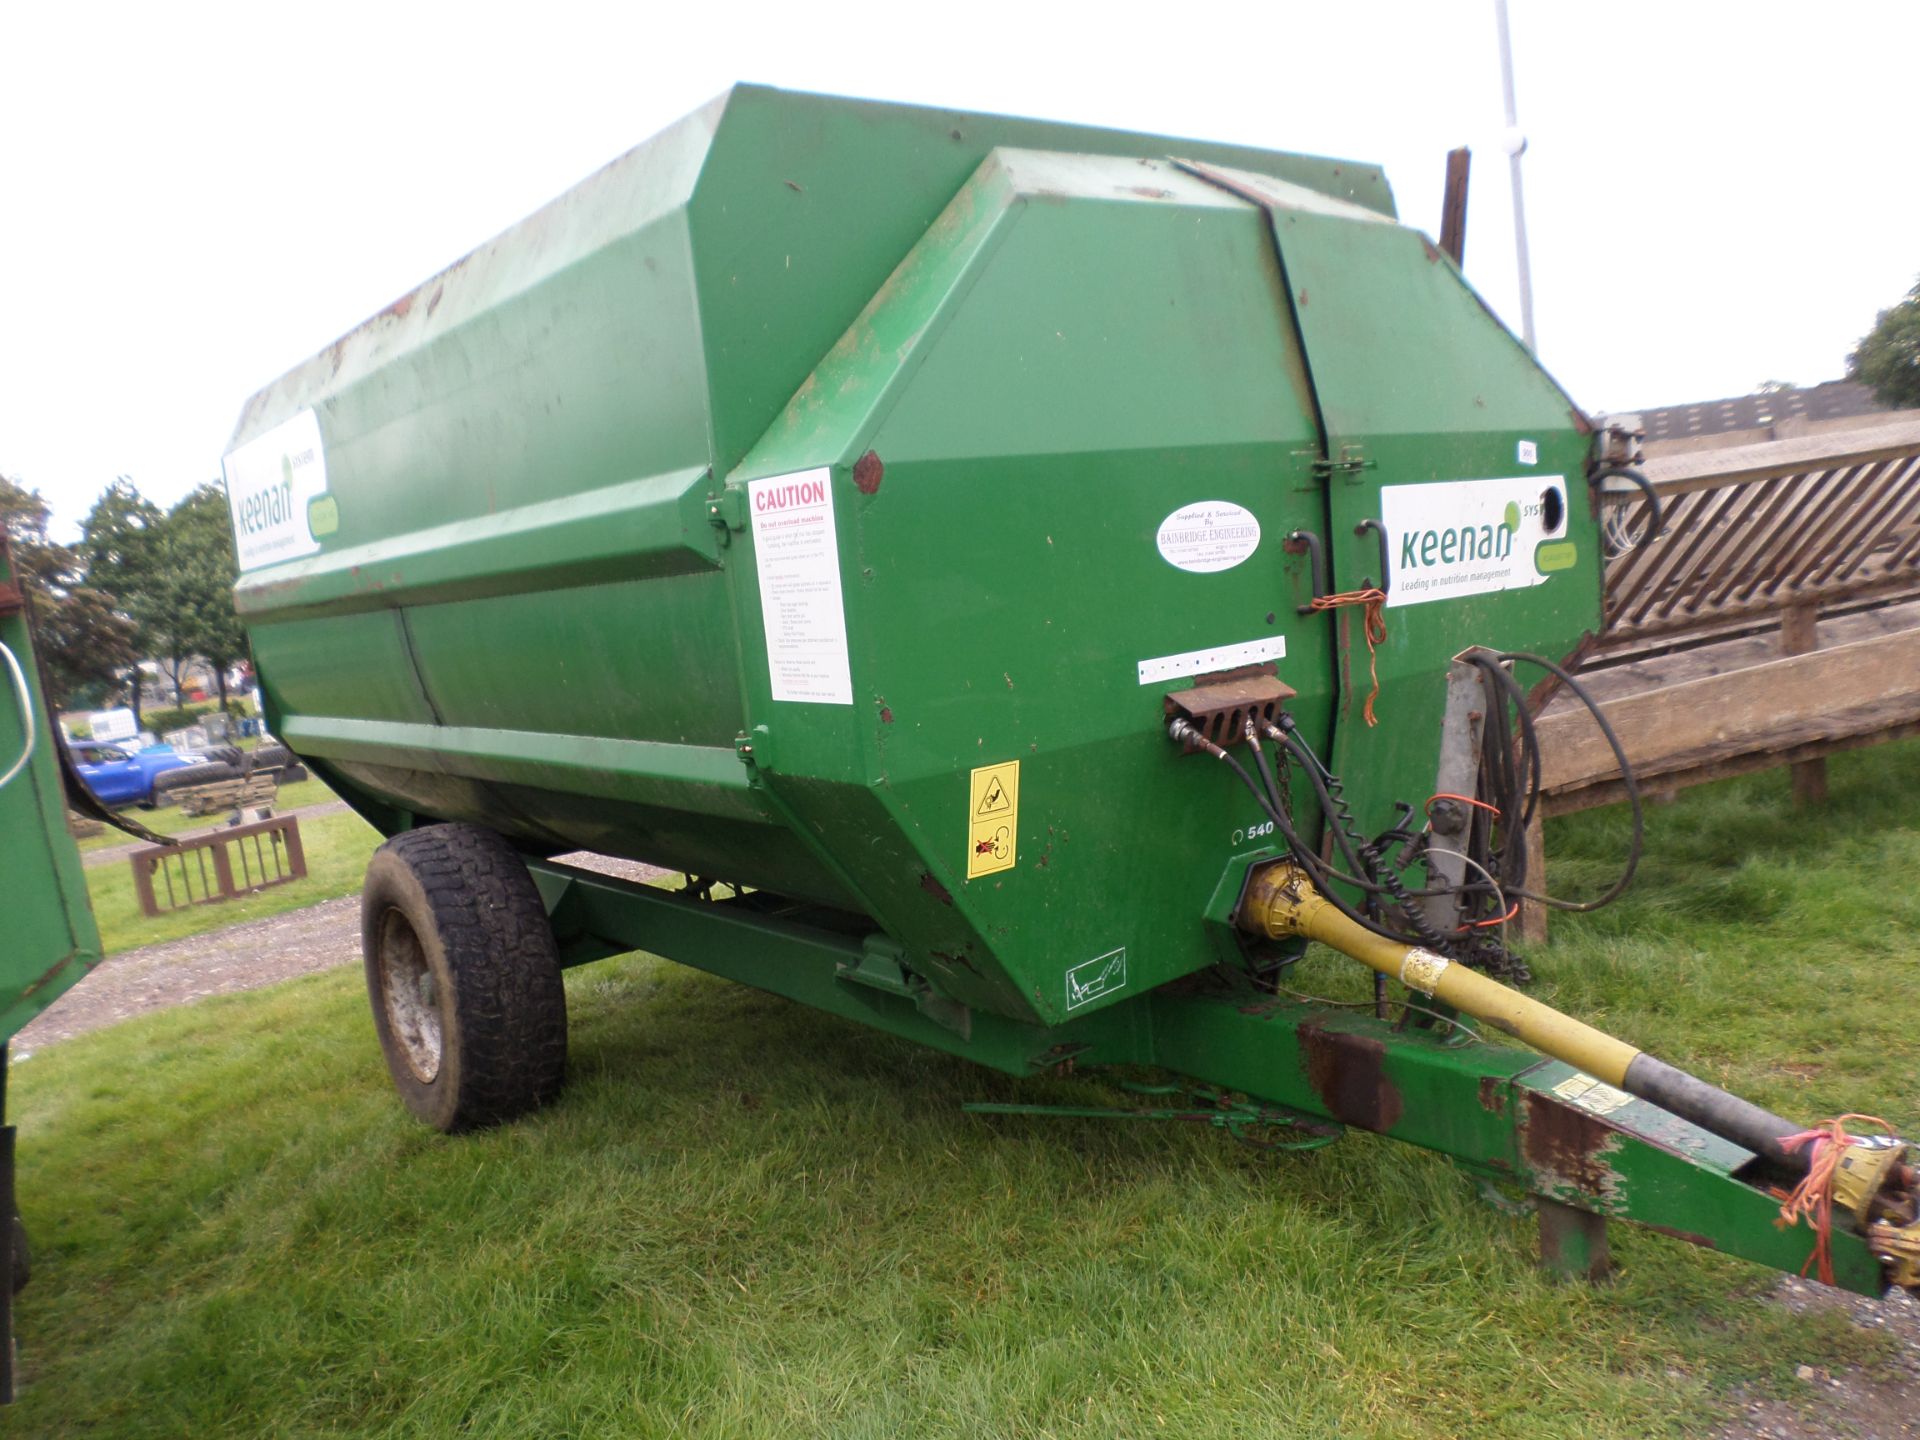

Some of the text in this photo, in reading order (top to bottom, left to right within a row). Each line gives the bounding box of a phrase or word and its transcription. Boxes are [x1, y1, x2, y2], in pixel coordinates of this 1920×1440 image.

[756, 480, 824, 512] CAUTION
[1176, 511, 1205, 521] Supplied
[1204, 518, 1214, 527] By
[1160, 526, 1257, 545] BAINBRIDGE ENGINEERING
[1401, 568, 1511, 591] Leading in nutrition management
[1247, 821, 1274, 840] 540
